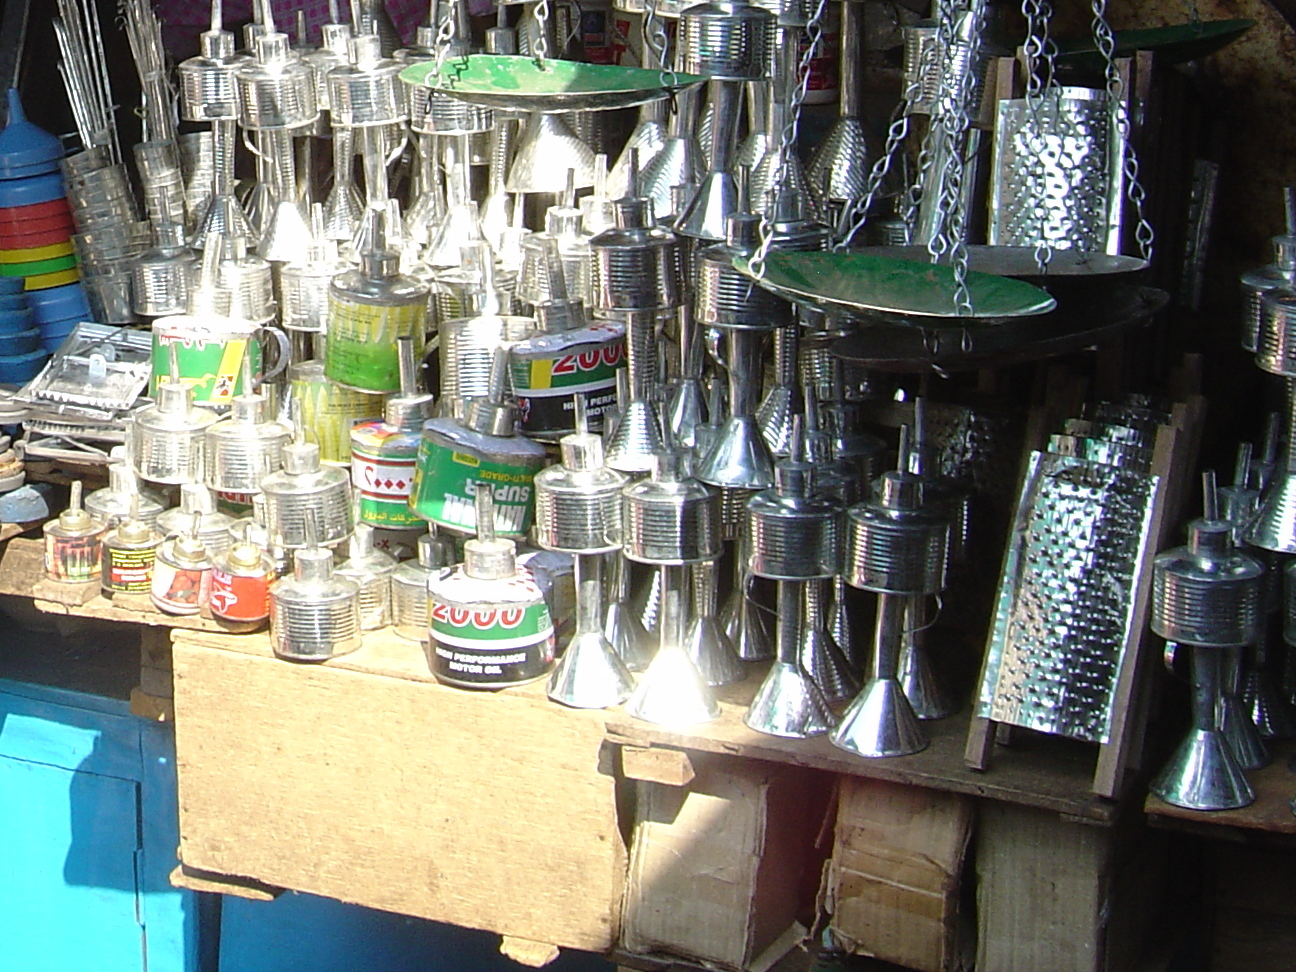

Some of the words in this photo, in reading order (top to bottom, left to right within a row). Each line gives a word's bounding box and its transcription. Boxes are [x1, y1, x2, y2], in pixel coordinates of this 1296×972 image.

[551, 341, 628, 376] 200
[441, 492, 527, 532] NATINAL
[432, 603, 526, 630] 2000
[449, 661, 483, 674] MOTOR
[484, 665, 503, 675] OIL
[453, 652, 527, 665] PERFORMANCE
